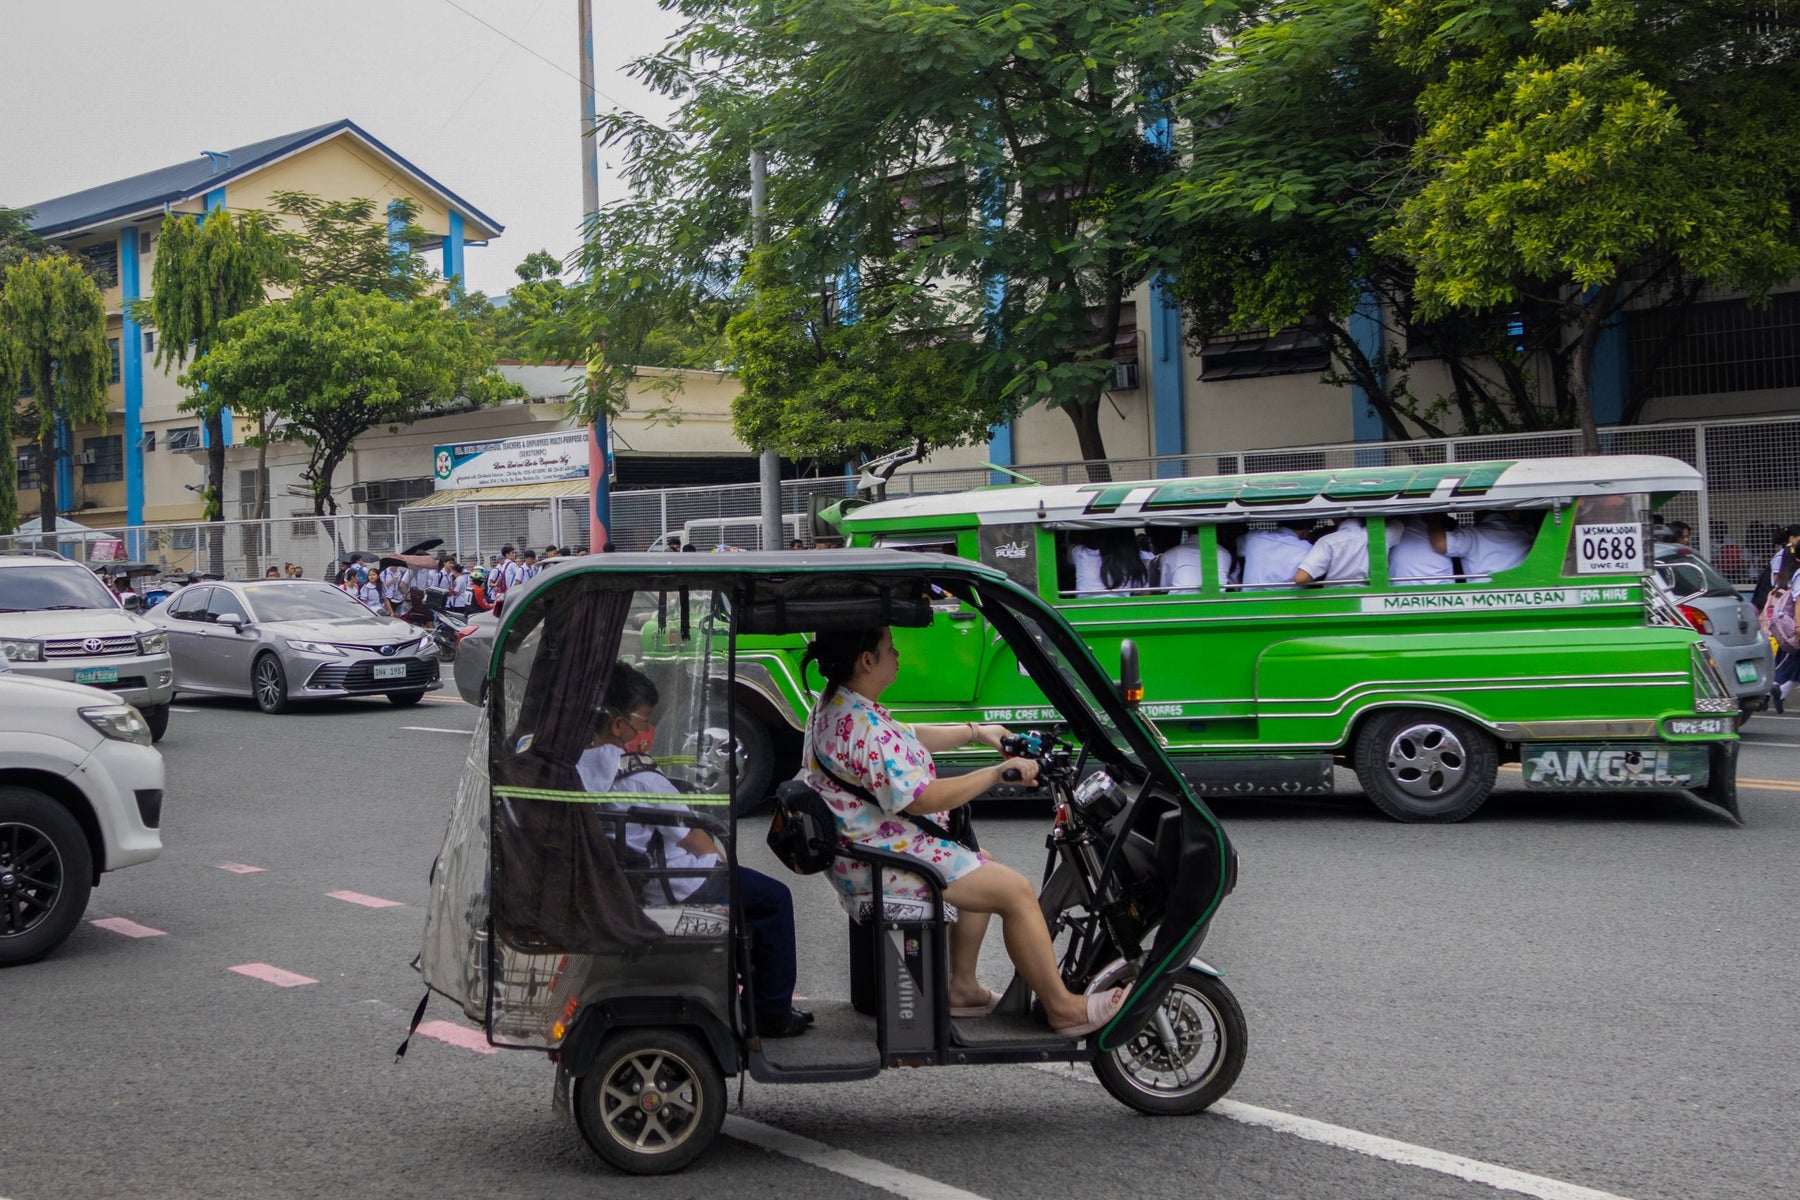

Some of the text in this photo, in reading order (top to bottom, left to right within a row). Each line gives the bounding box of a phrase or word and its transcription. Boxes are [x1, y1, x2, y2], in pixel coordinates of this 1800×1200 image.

[1583, 536, 1636, 560] 0688
[1580, 589, 1629, 601] FOR HIRE
[1015, 709, 1040, 720] CASE
[1529, 750, 1691, 783] ANGEL
